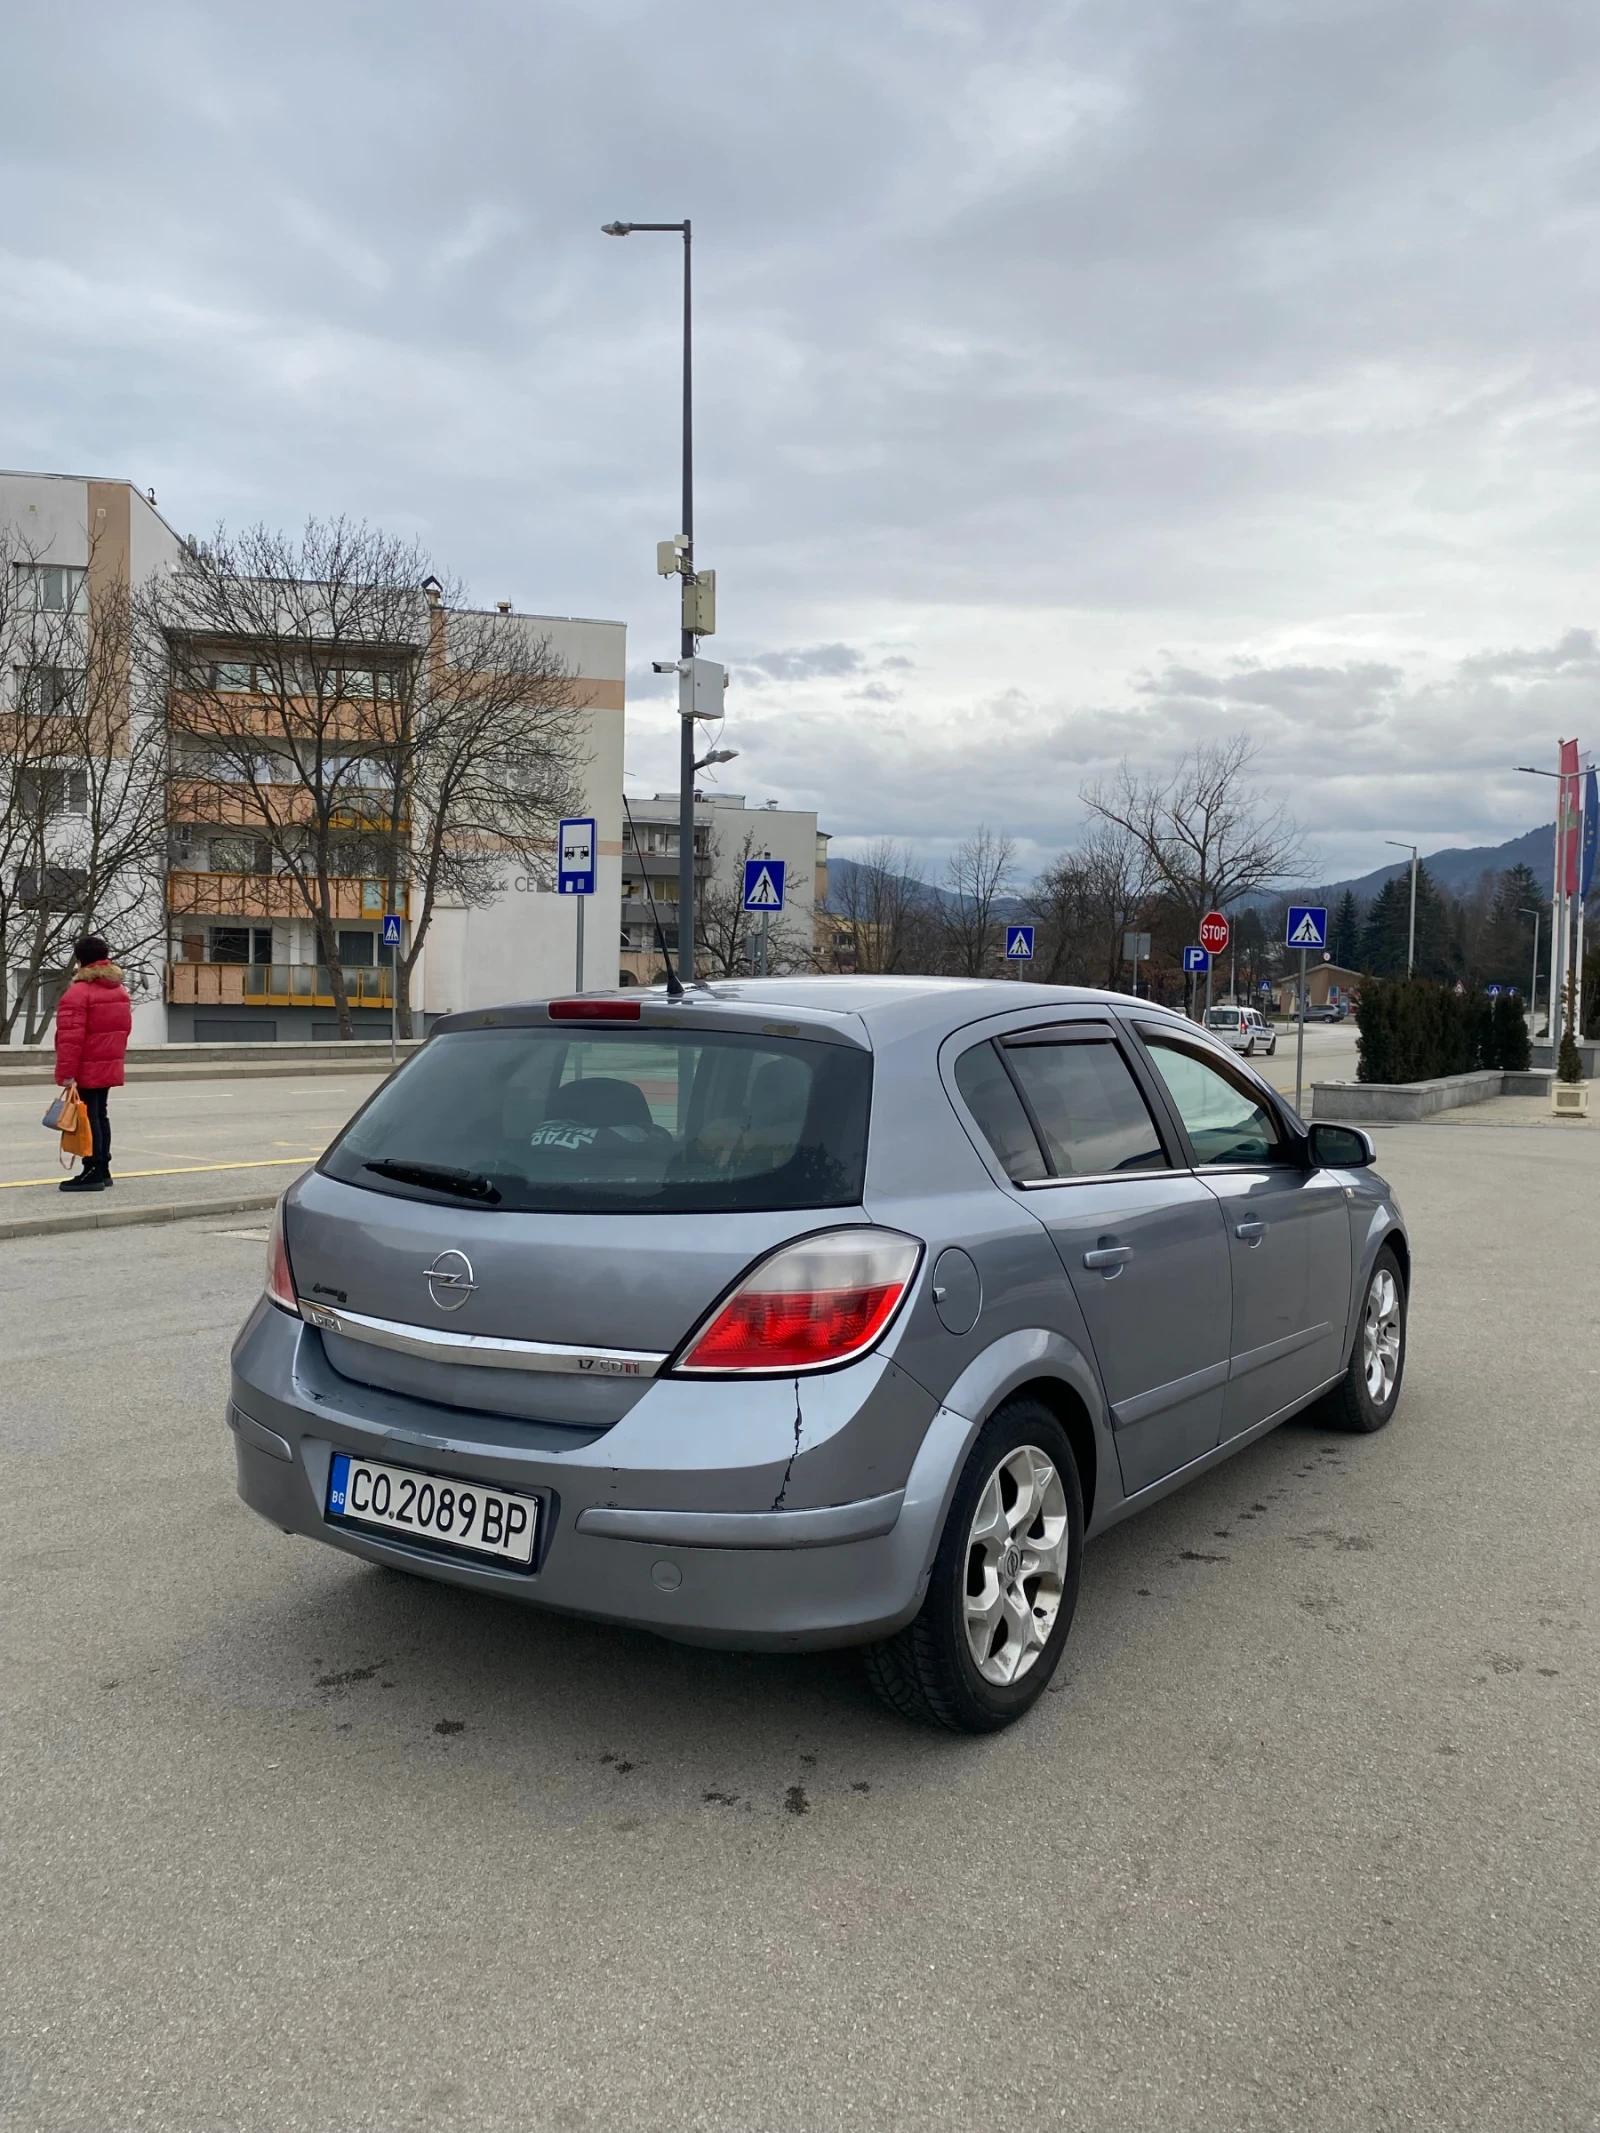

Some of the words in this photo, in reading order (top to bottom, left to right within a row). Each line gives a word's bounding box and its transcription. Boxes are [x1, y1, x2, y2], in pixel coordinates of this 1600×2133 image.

[1202, 925, 1227, 941] STOP
[1189, 950, 1204, 969] P
[310, 1312, 342, 1331] ASTRA
[599, 1359, 640, 1375] CDTI
[332, 1490, 345, 1504] BG
